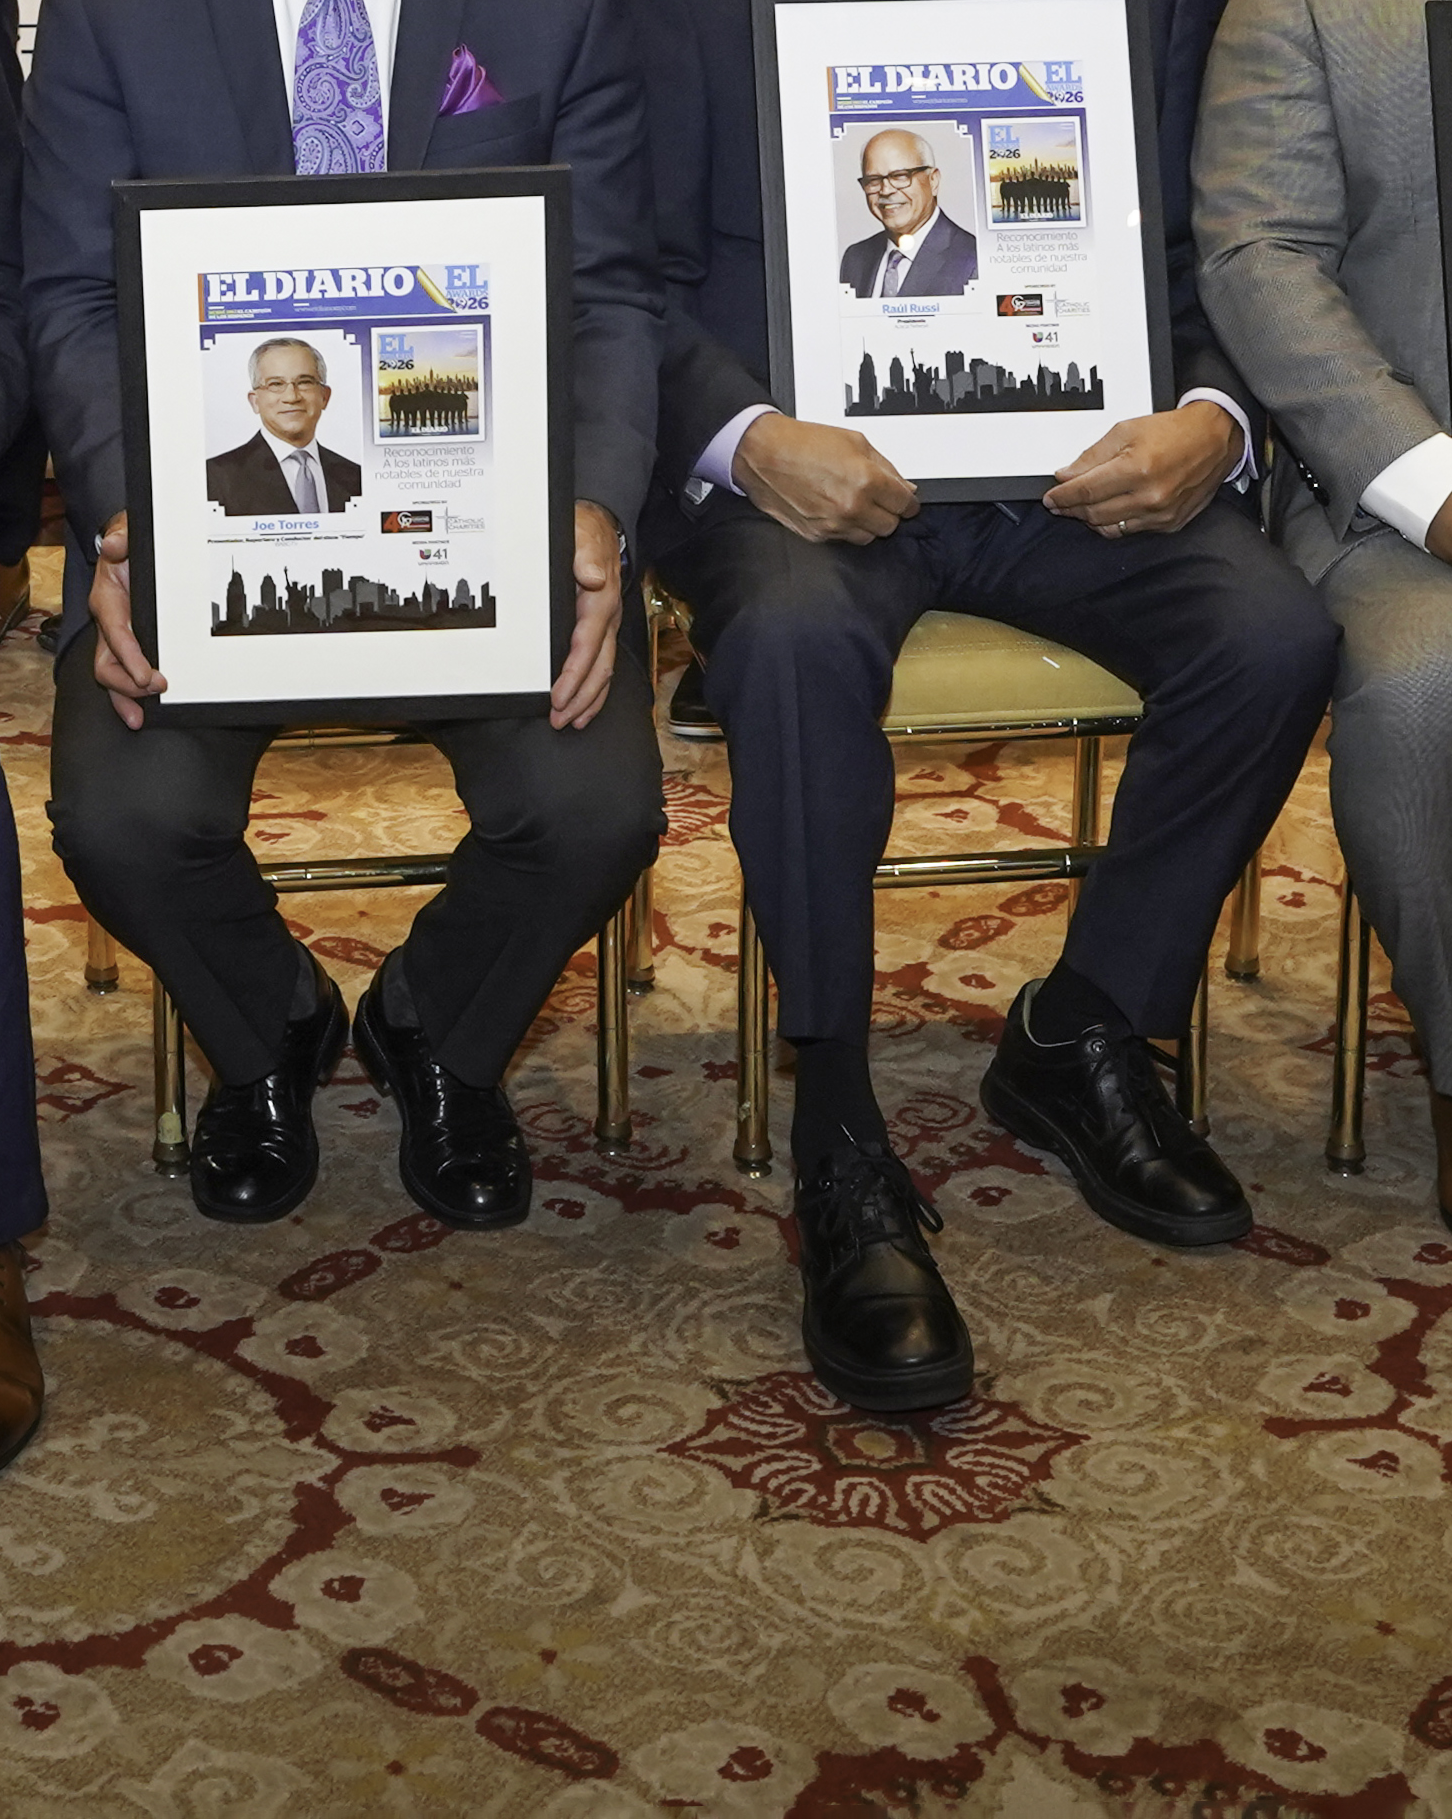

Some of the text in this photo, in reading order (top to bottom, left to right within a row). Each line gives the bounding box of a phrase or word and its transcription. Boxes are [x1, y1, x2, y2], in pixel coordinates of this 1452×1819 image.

[835, 63, 1018, 93] EL DIARIO
[1043, 61, 1081, 84] EL
[445, 264, 488, 289] EL
[207, 267, 415, 301] EL DIARIO
[882, 303, 939, 313] Raúl Russi
[1045, 331, 1058, 342] 41
[383, 444, 474, 458] Reconocimiento
[393, 458, 408, 468] los
[411, 456, 448, 467] latinos
[374, 468, 422, 479] notables
[424, 468, 440, 478] de
[397, 478, 461, 490] comunidad
[252, 519, 319, 531] Joe Torres
[433, 548, 448, 559] 41
